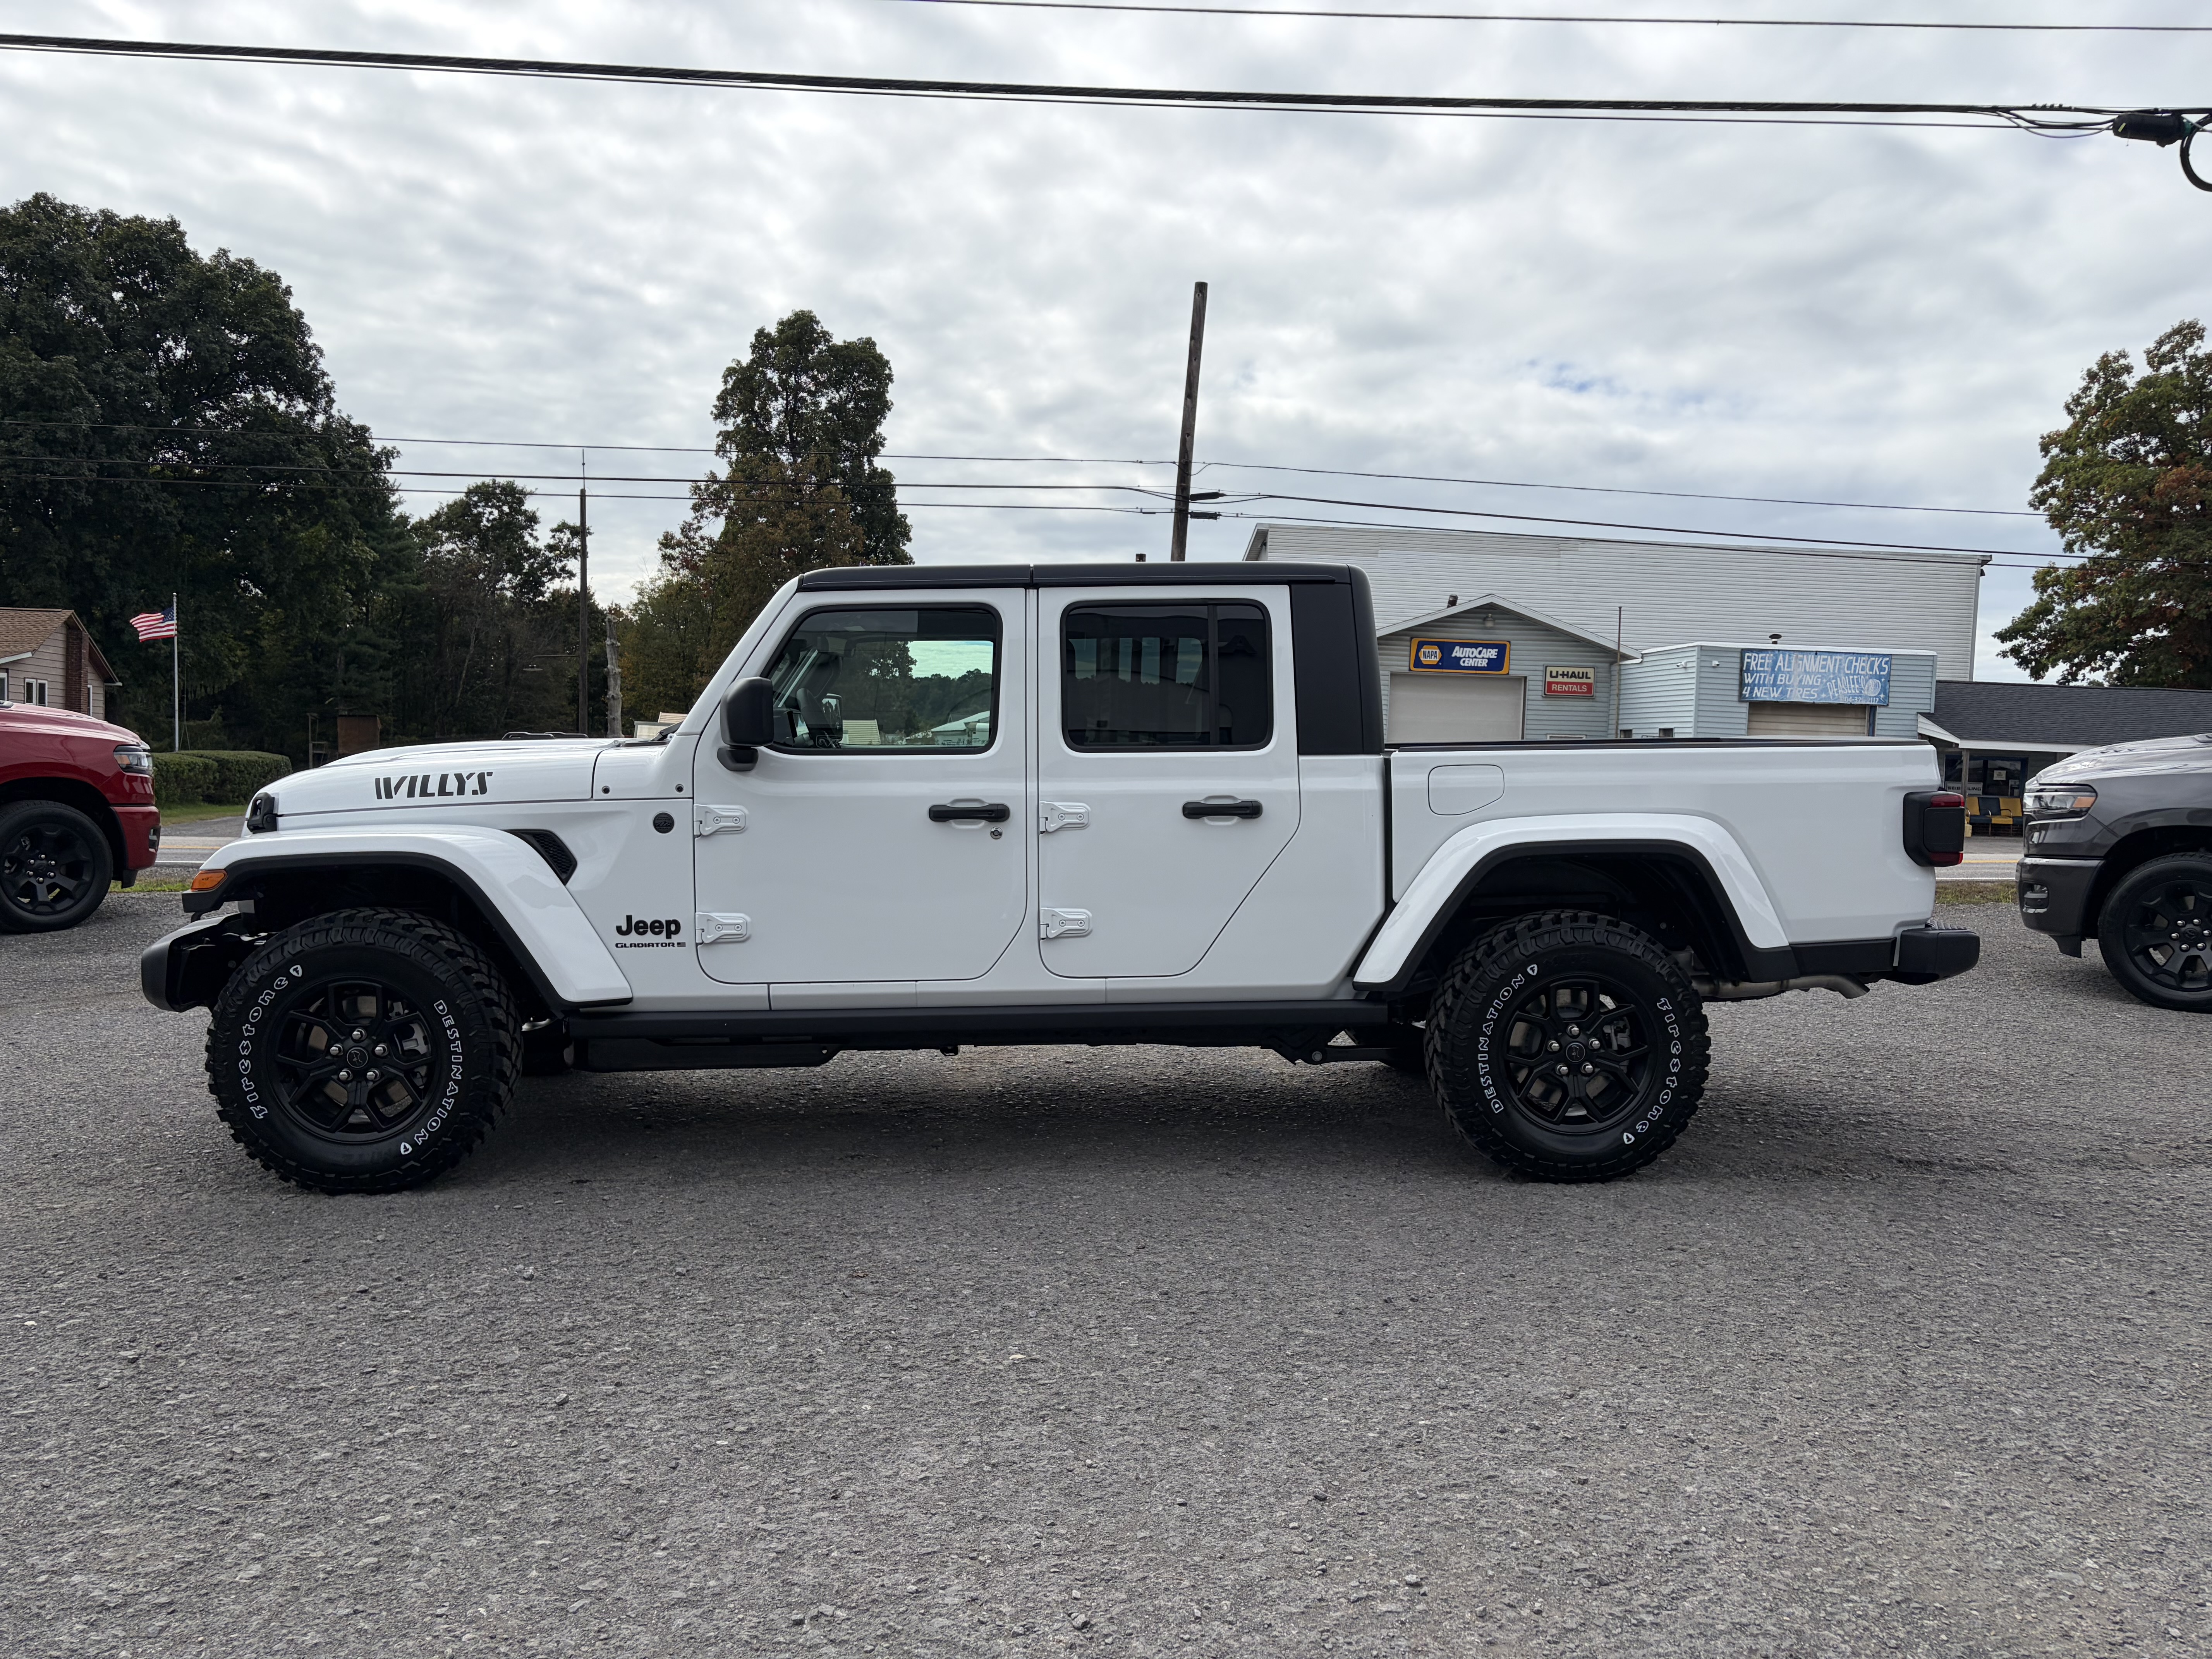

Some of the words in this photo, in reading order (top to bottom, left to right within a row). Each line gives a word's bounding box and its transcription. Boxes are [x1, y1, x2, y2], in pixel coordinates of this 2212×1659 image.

[1422, 650, 1438, 660] NAPA
[1460, 658, 1488, 667] CENTER
[1743, 653, 1773, 671] FREE
[1775, 654, 1842, 673] ALIGNMENT
[1845, 656, 1889, 675] CHECKS
[1550, 670, 1591, 679] U-HAUL
[1744, 673, 1775, 684] WITH
[1777, 674, 1822, 685] BUYING
[1552, 684, 1587, 692] RENTALS
[1742, 687, 1751, 697] 4
[1753, 687, 1783, 697] NEW
[1786, 688, 1818, 699] TRES
[375, 772, 493, 800] WILLYS
[616, 915, 681, 939] Jeep
[239, 977, 288, 1119] Firestone
[1478, 974, 1525, 1114] DESTINATION
[414, 1000, 462, 1145] DESTINATION
[1636, 998, 1681, 1133] Firestone
